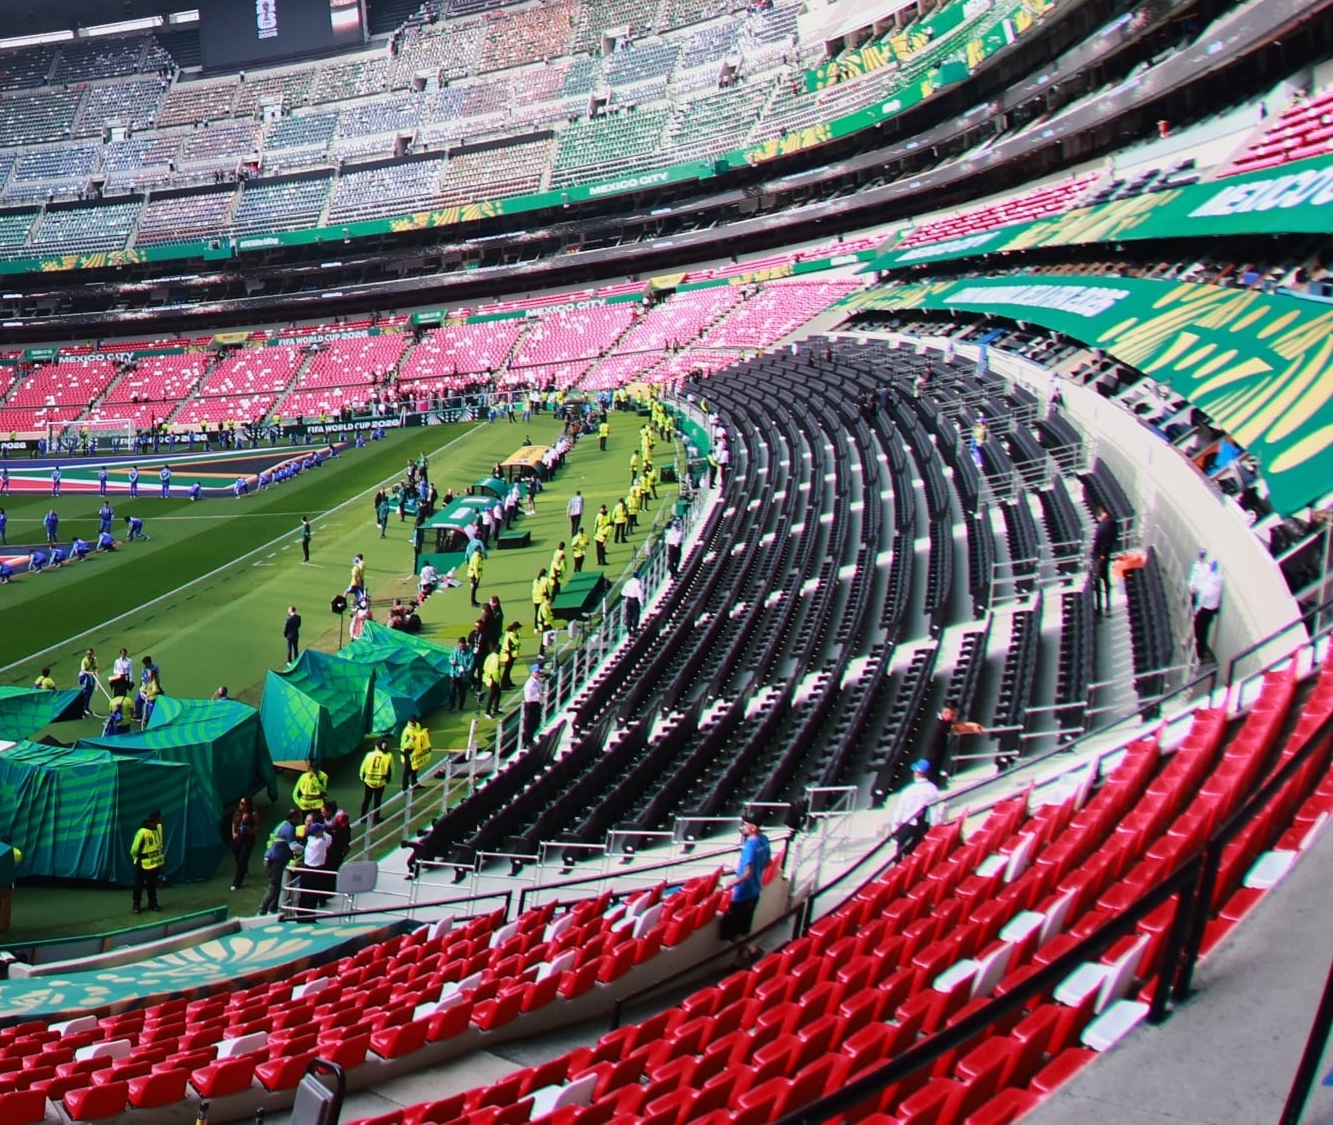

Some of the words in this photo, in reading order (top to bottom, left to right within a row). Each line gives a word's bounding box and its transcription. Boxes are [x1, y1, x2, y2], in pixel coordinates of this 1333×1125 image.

[589, 178, 638, 196] MEXICO
[639, 171, 669, 185] CITY
[525, 302, 575, 317] MEXICO
[576, 298, 606, 310] CITY
[279, 337, 296, 346] FIFA
[296, 335, 324, 344] WORLD
[324, 333, 339, 342] CUP
[339, 330, 369, 339] 2026
[59, 353, 105, 363] MEXICO
[106, 351, 135, 360] CITY
[325, 423, 353, 432] WORLD
[354, 421, 370, 430] CUP
